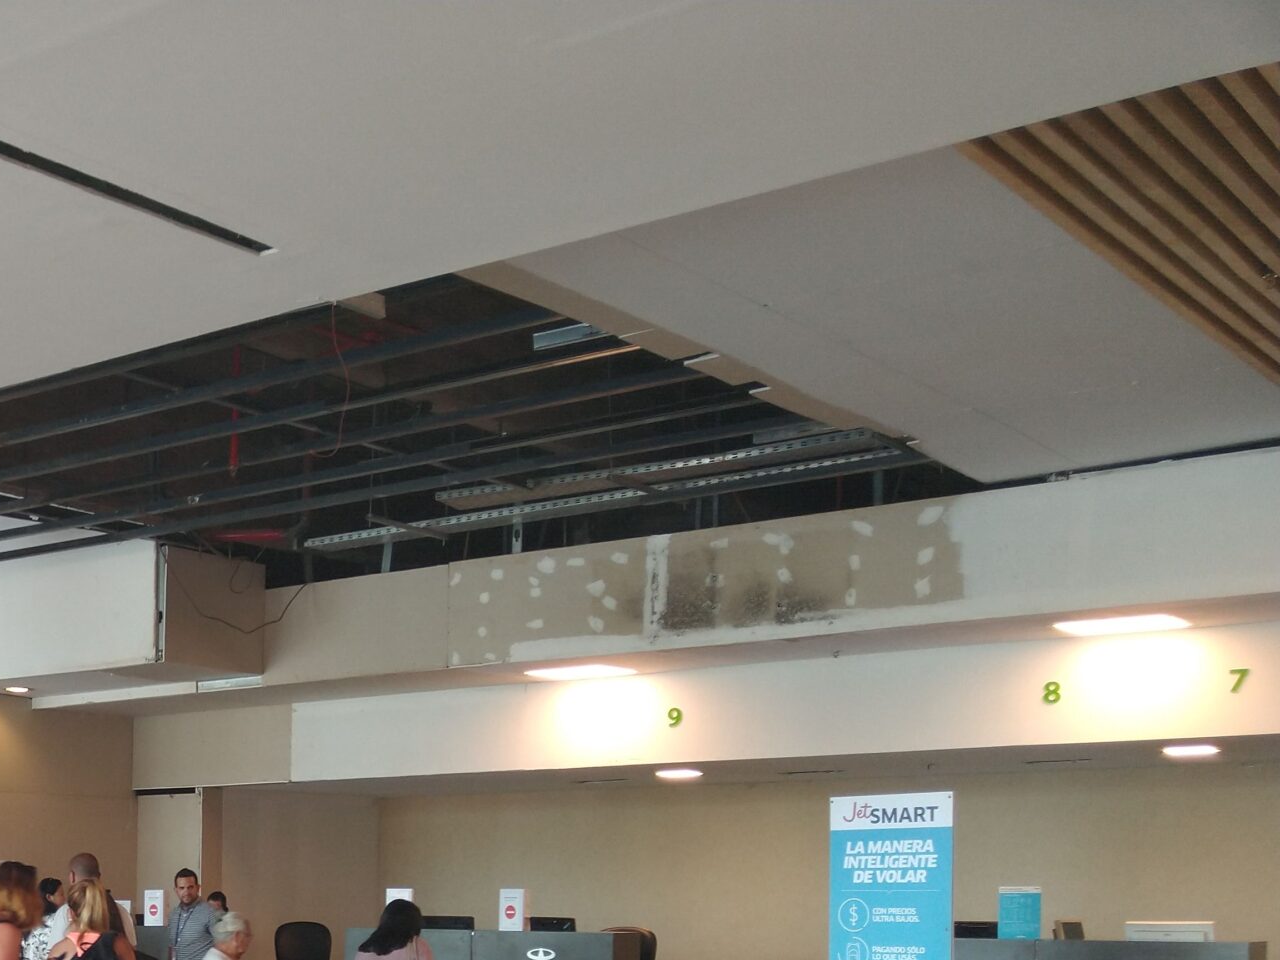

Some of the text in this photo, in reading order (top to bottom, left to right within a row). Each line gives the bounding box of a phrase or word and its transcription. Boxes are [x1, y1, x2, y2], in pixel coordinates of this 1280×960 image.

[1229, 668, 1250, 693] 7
[1042, 681, 1061, 705] 8
[668, 707, 683, 728] 9
[842, 801, 940, 824] JetSMART
[846, 839, 934, 854] LA MANERA
[843, 854, 938, 869] INTELIGENTE
[853, 869, 927, 883] DE VOLAR
[872, 907, 887, 915] CON
[882, 953, 897, 960] QUE
